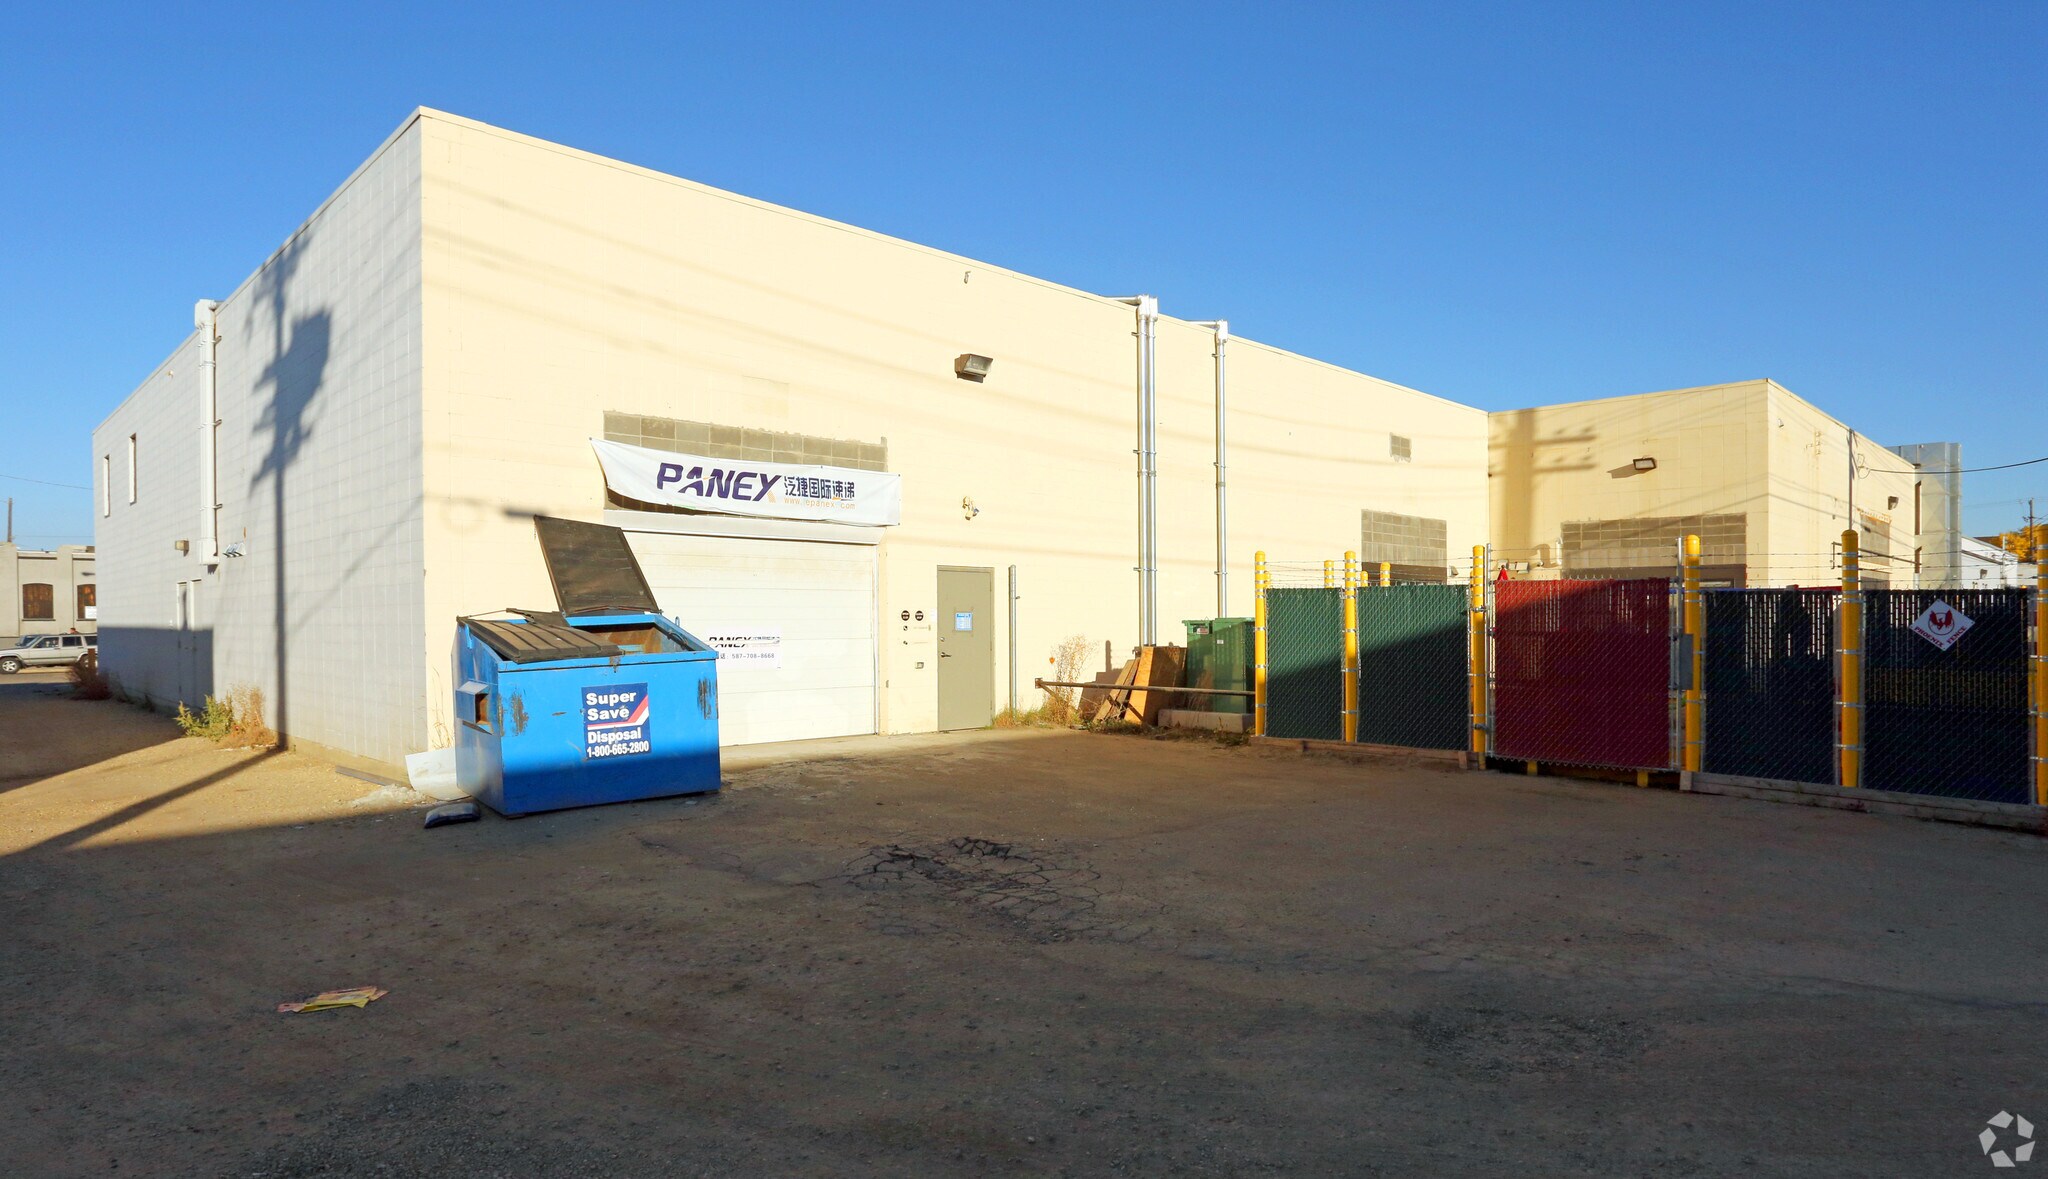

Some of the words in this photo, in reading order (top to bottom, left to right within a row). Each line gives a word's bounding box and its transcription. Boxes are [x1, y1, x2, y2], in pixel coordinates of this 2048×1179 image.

[784, 475, 855, 499] 泛捷国际速递
[1914, 626, 1945, 648] PHOENIX
[1947, 626, 1967, 645] FENCE
[586, 691, 637, 707] Super
[587, 706, 630, 721] Save
[587, 727, 642, 745] Disposal
[586, 740, 650, 758] 1-800-665-2800
